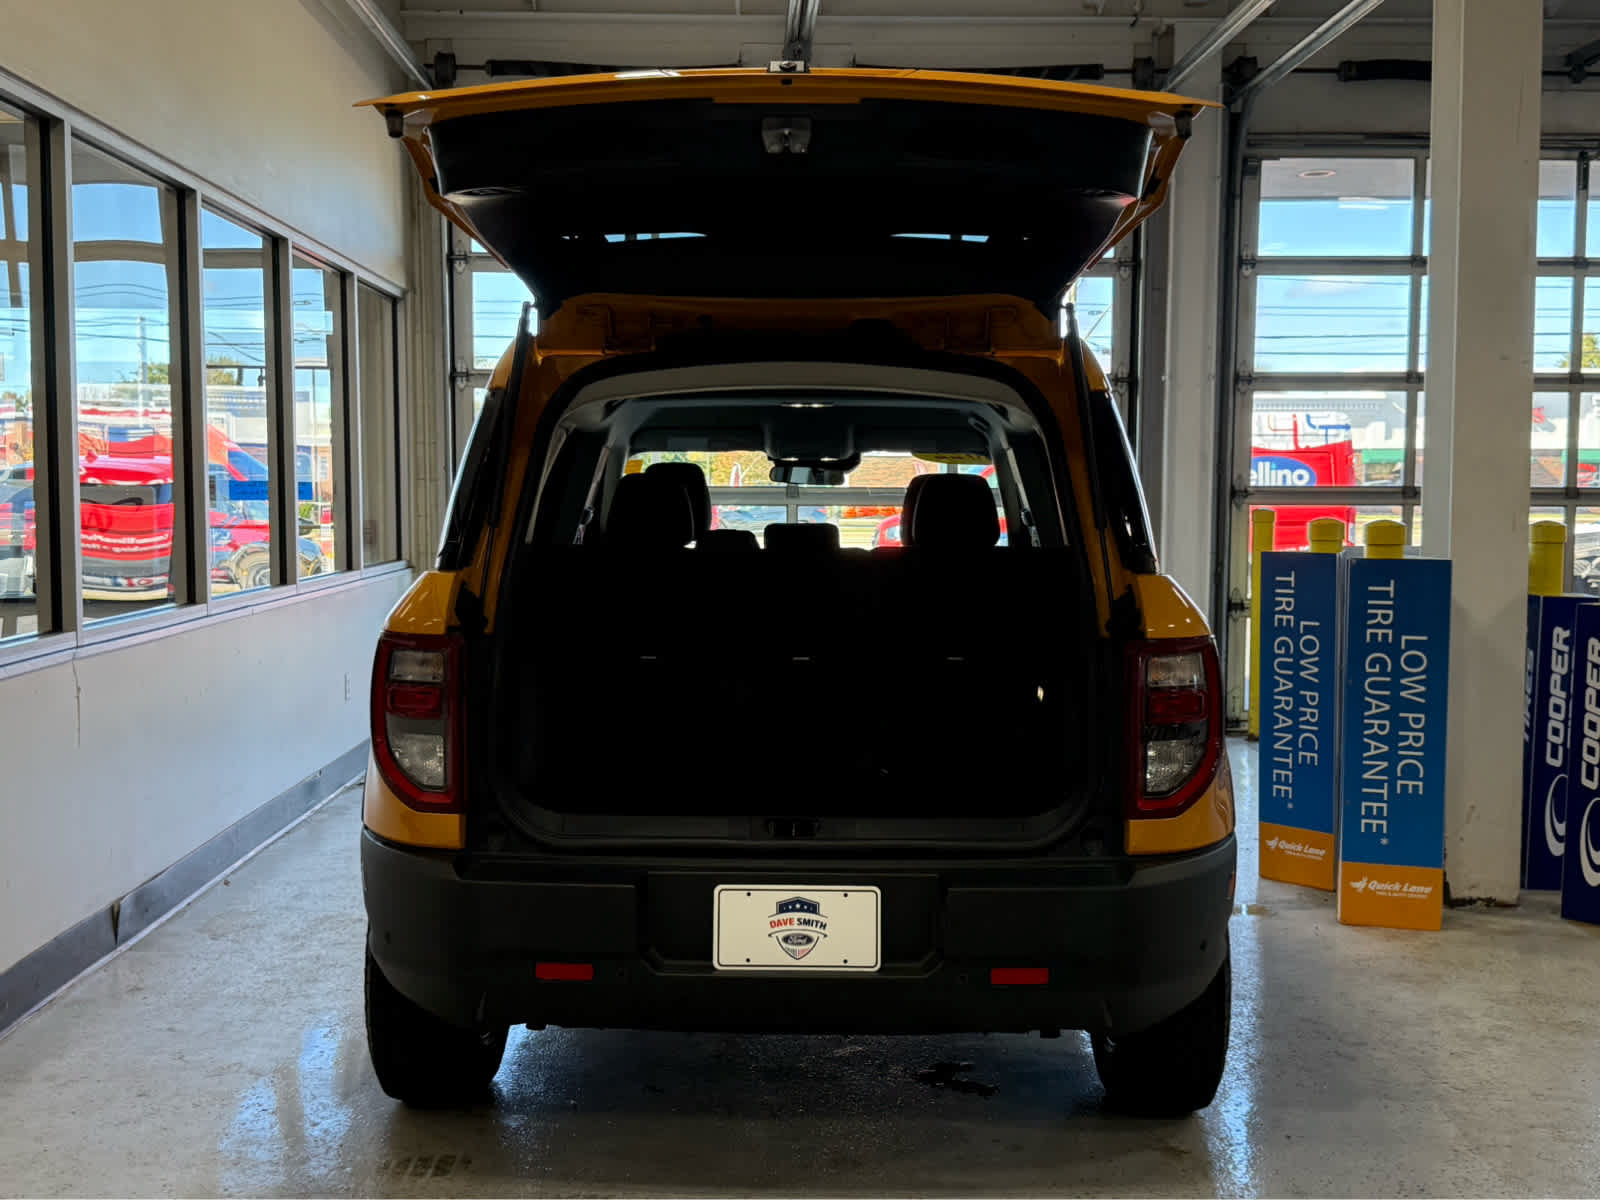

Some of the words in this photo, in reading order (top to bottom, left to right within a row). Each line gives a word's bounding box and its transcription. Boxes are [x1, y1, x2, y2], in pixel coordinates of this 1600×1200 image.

[1274, 570, 1295, 628] TIRE
[1366, 579, 1395, 643] TIRE
[1299, 621, 1320, 683] LOW
[1399, 635, 1428, 703] LOW
[1298, 690, 1319, 766] PRICE
[1545, 626, 1571, 768] COOPER
[1580, 637, 1600, 791] COOPER
[1396, 712, 1425, 795] PRICE
[1367, 880, 1401, 892] Quick
[1402, 882, 1432, 894] Lane
[769, 917, 795, 929] DAVE
[797, 918, 827, 930] SMITH
